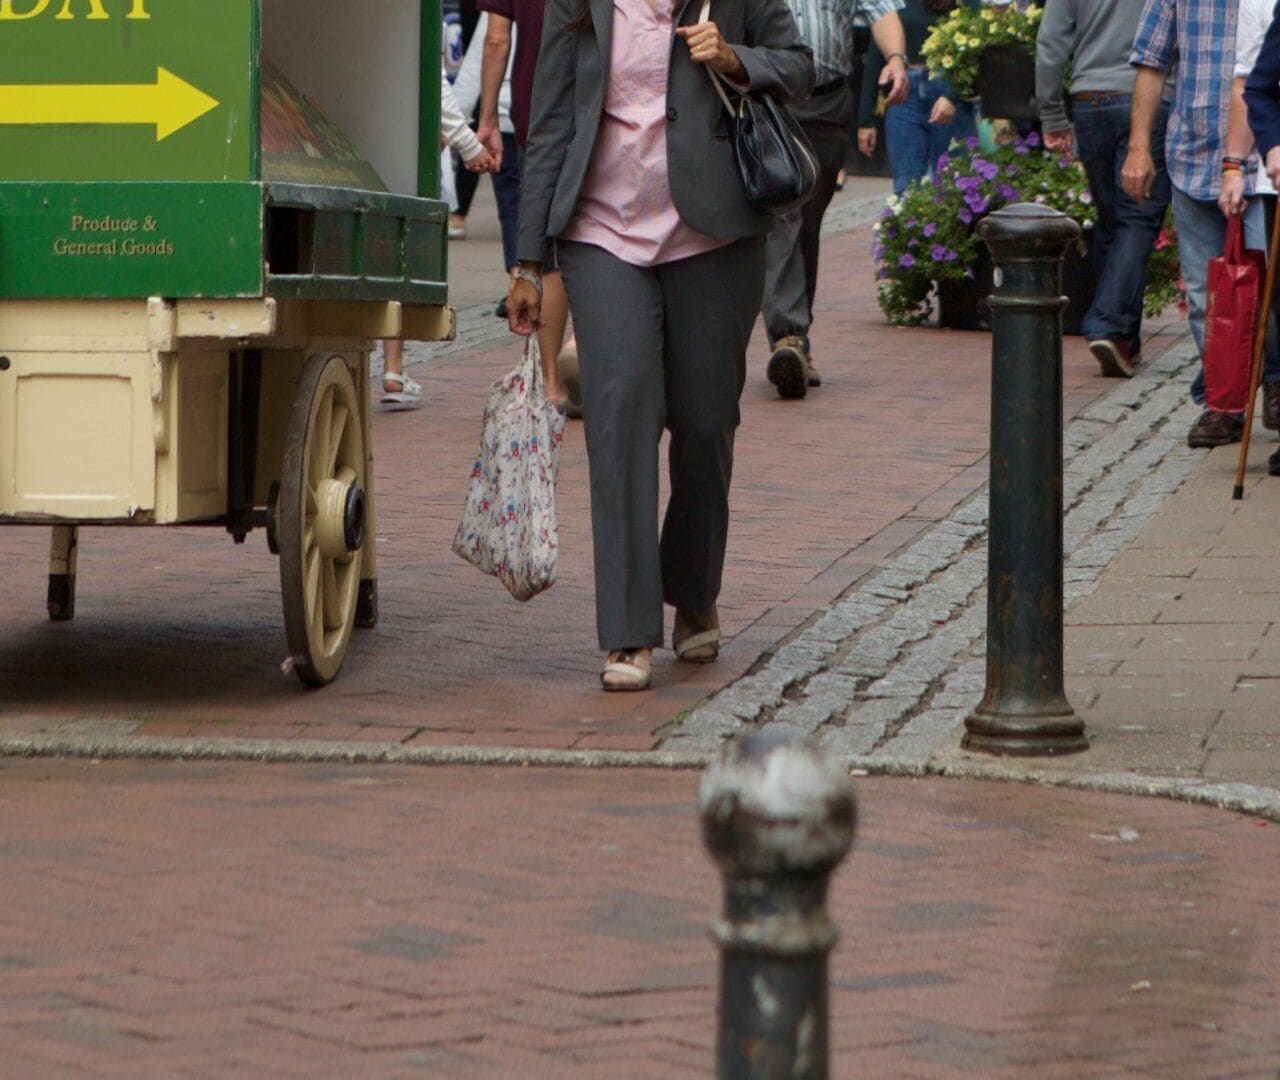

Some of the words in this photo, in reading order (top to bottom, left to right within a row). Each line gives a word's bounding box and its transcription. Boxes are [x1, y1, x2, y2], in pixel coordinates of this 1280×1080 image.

[71, 216, 138, 232] Produce
[142, 216, 157, 232] &
[53, 238, 117, 255] General
[122, 238, 175, 255] Goods
